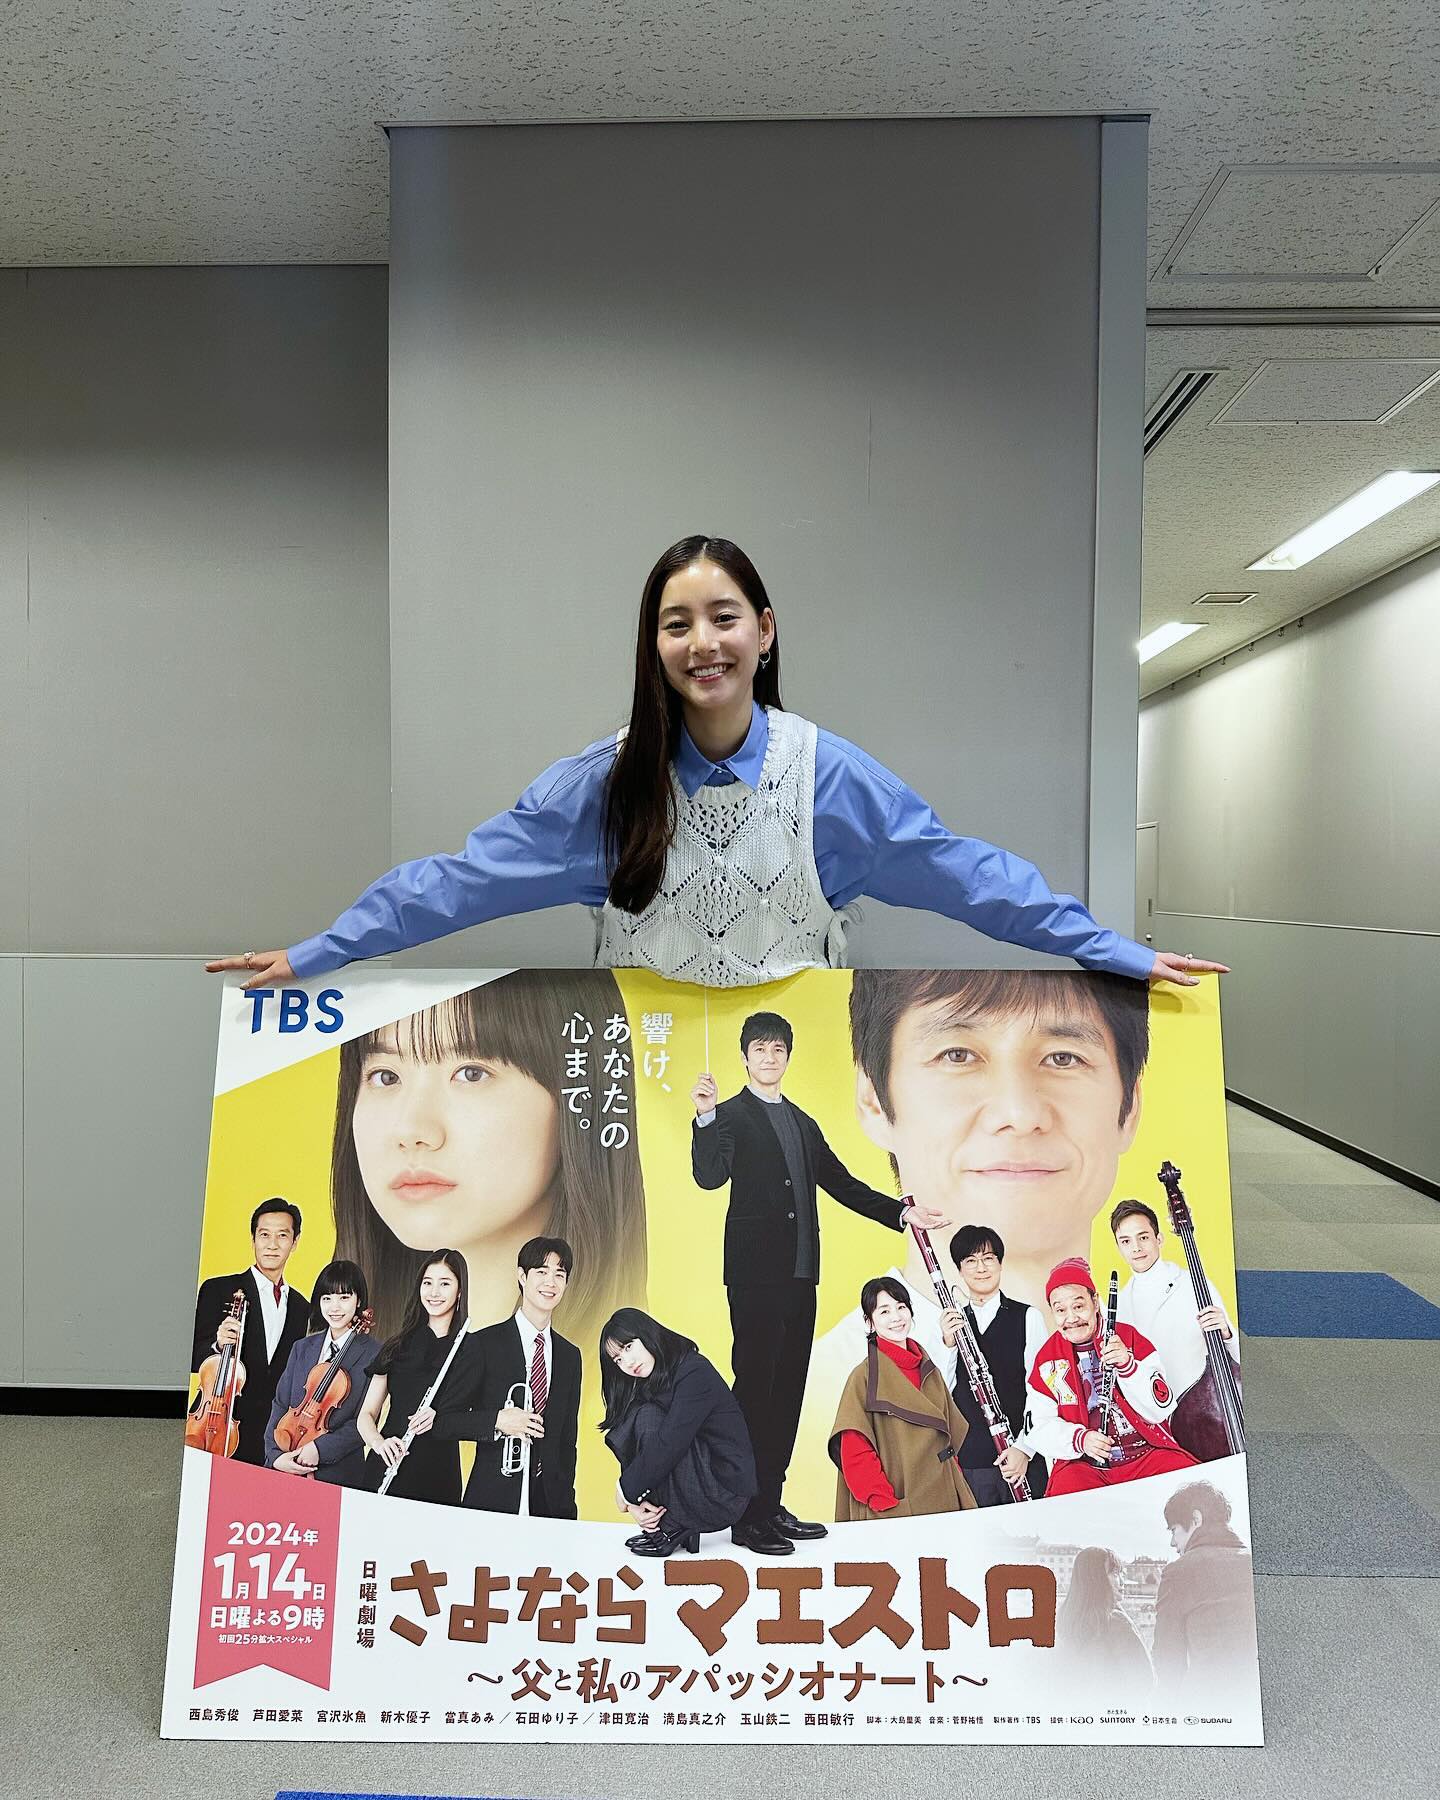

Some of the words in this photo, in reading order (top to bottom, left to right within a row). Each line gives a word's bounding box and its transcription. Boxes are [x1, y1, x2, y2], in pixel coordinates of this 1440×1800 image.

[244, 989, 344, 1034] TBS
[561, 1012, 594, 1130] 心まで。
[641, 1012, 673, 1093] 響け、
[600, 1013, 631, 1149] あなたの
[227, 1521, 319, 1547] 2024年
[213, 1552, 326, 1601] 1月14日
[210, 1605, 326, 1631] 日曜よる9時
[356, 1560, 378, 1649] 日曜劇場
[218, 1633, 313, 1645] 初回25分拡大スペシャル
[189, 1708, 240, 1722] 西島秀俊
[252, 1708, 304, 1722] 芦田愛菜
[316, 1710, 367, 1723] 宮沢氷魚
[380, 1710, 431, 1724] 新木優子
[599, 1712, 650, 1726] 津田寛治
[663, 1712, 727, 1726] 満島真之介
[740, 1713, 791, 1726] 玉山鉄二
[804, 1713, 855, 1726] 西田敏行
